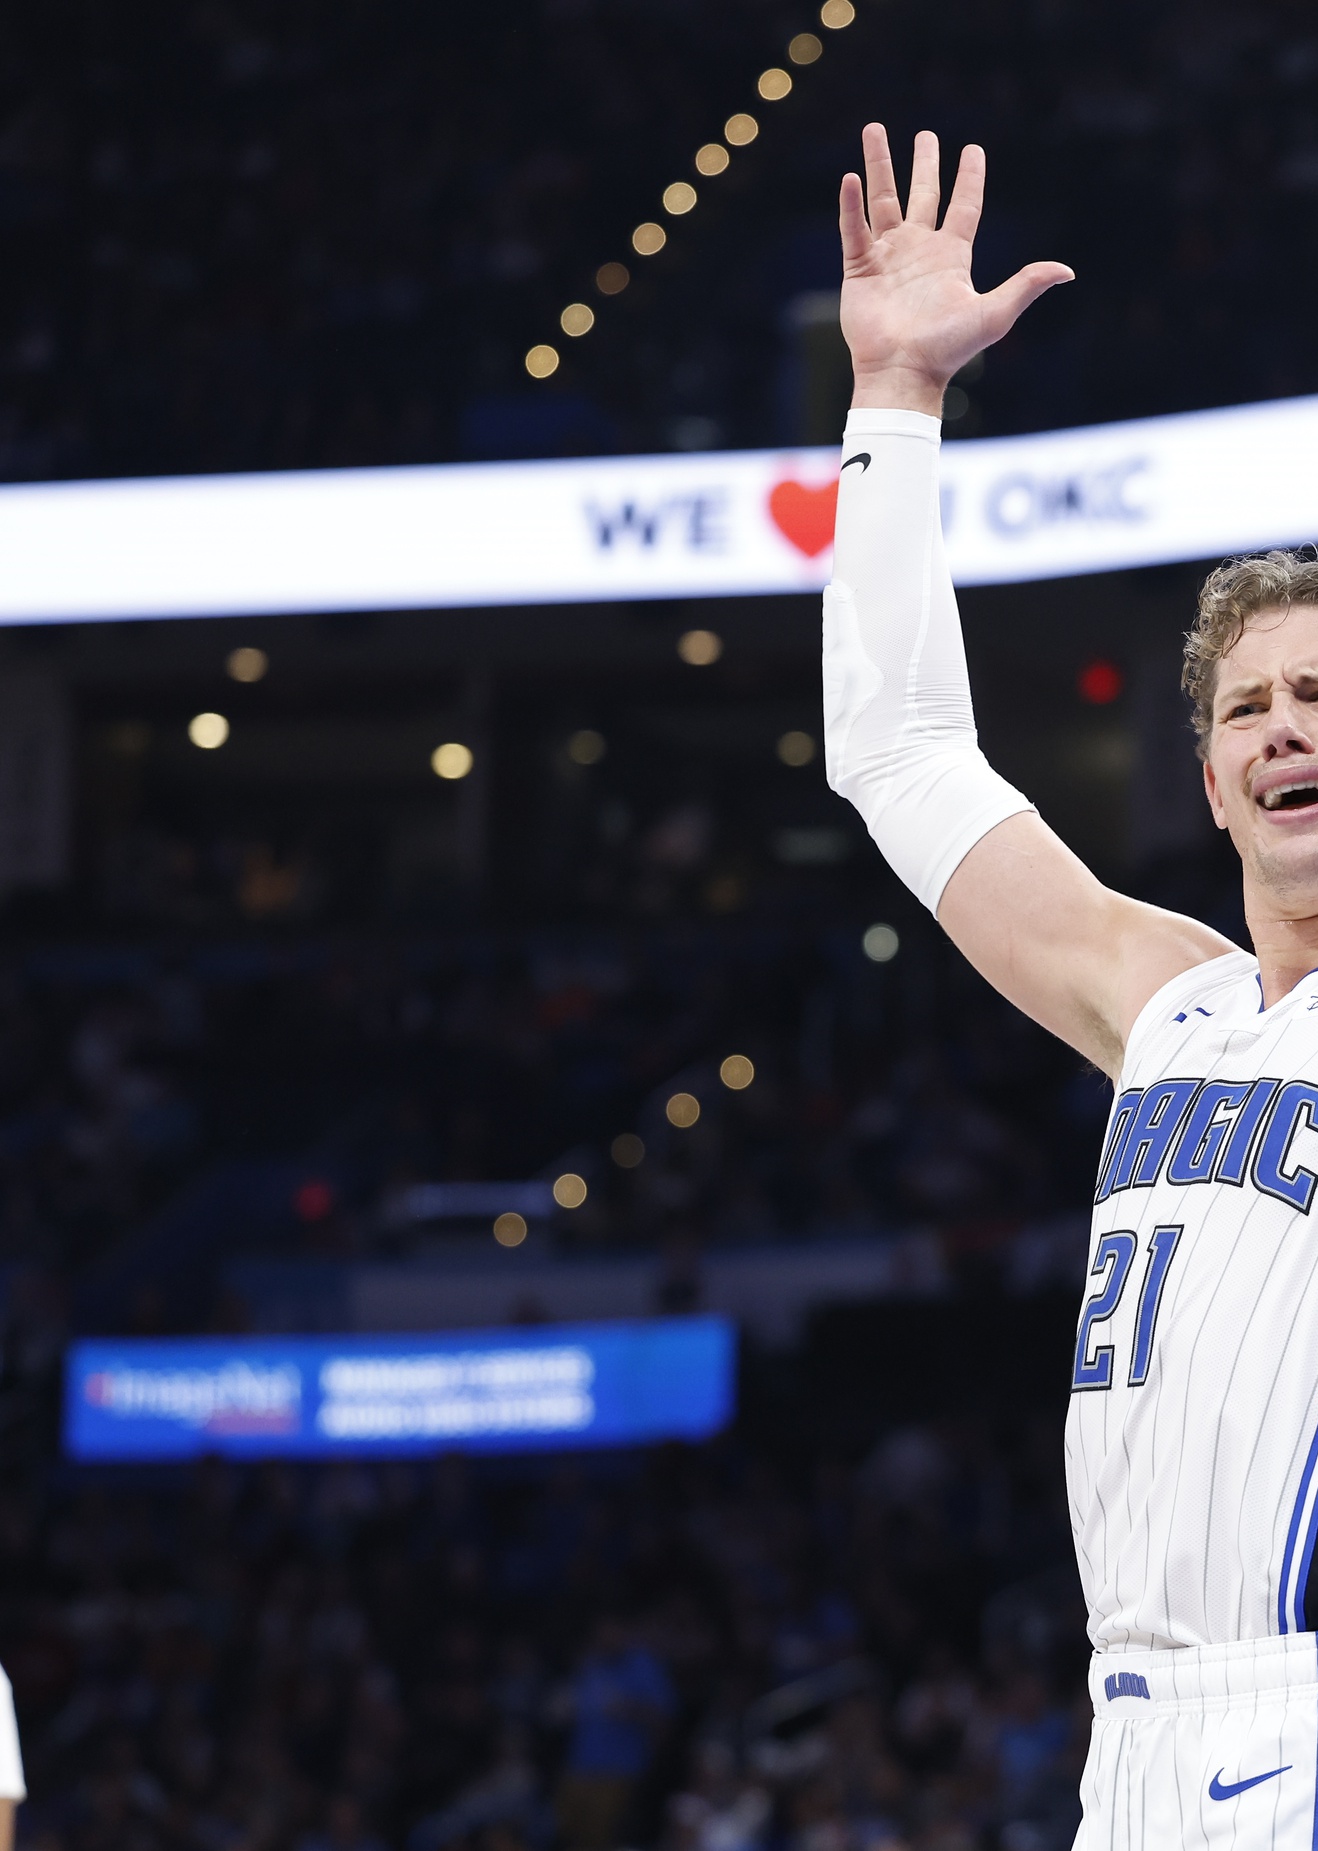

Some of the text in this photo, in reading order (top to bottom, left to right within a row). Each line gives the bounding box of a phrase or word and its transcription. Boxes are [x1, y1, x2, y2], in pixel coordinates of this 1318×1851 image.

[583, 486, 730, 554] WE
[984, 456, 1155, 541] OKC
[1071, 1224, 1184, 1393] 21
[1104, 1671, 1151, 1702] ORLANDO
